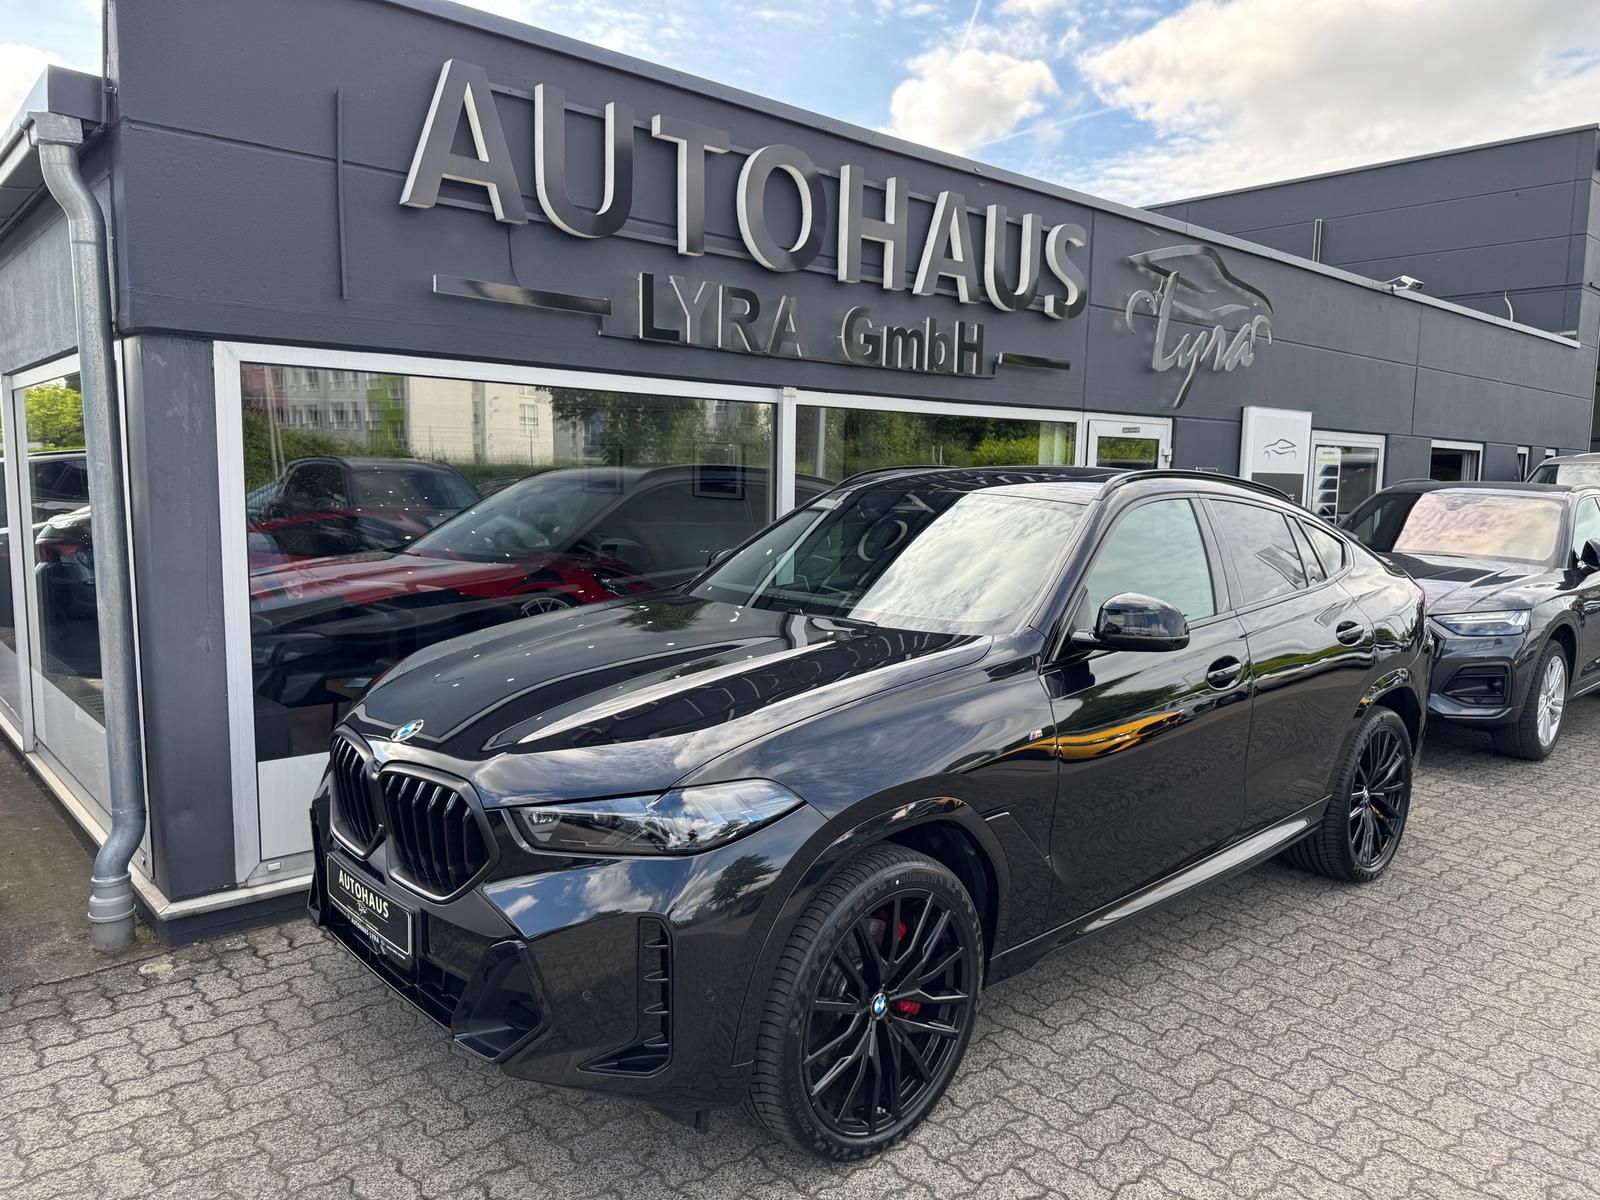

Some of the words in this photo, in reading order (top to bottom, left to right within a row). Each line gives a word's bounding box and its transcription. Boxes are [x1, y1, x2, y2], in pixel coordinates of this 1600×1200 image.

[400, 59, 1087, 319] AUTOHAUS
[638, 272, 808, 359] LYRA
[839, 306, 985, 377] GmbH
[338, 869, 389, 918] AUTOHAUS
